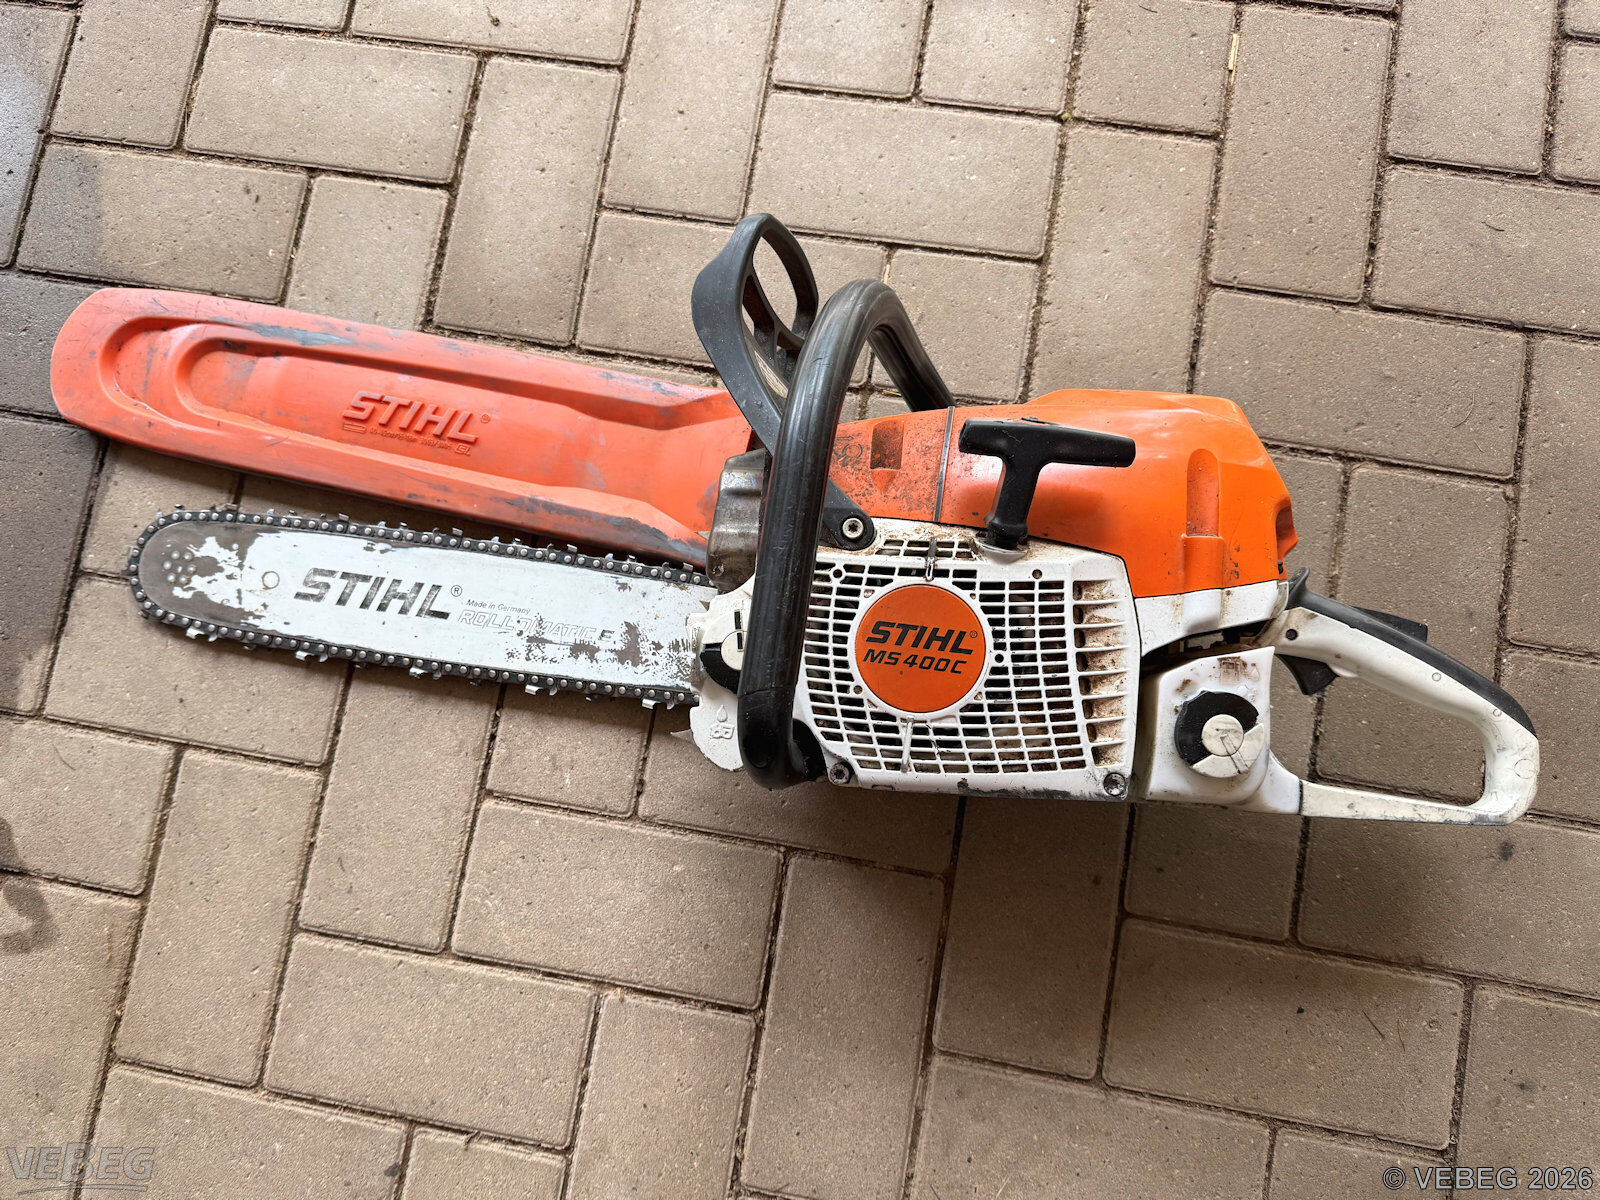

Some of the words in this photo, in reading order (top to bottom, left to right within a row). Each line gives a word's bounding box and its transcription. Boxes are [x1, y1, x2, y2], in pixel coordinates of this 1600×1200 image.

[466, 599, 487, 609] Made
[489, 601, 496, 610] in
[498, 603, 531, 615] Germany
